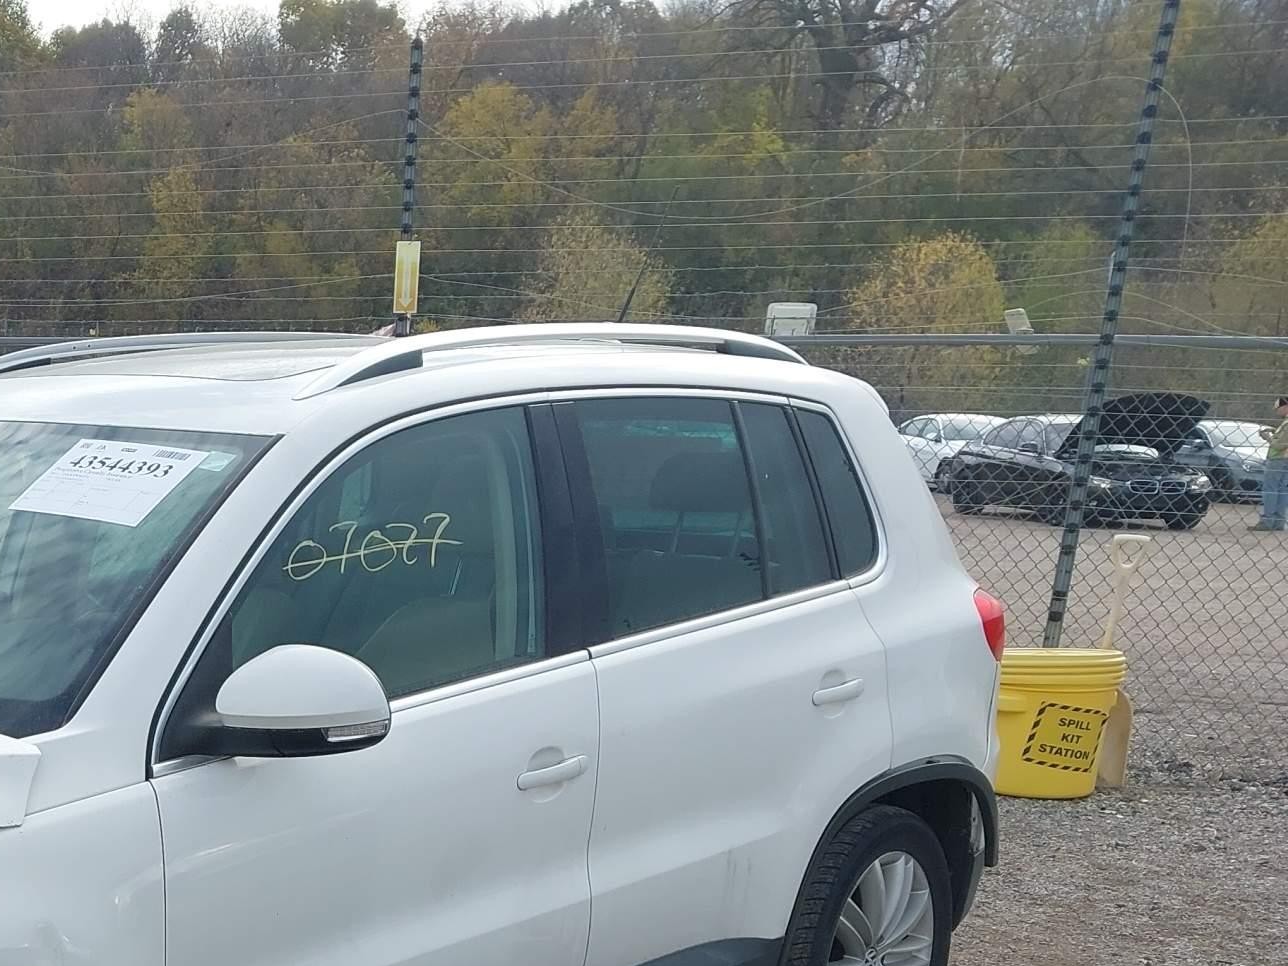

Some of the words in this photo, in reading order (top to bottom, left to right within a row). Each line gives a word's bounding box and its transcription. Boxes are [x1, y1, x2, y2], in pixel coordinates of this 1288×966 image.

[70, 455, 173, 478] 43544393
[1058, 718, 1091, 730] SPILL
[1061, 734, 1082, 744] KIT
[1038, 743, 1090, 760] STATION
